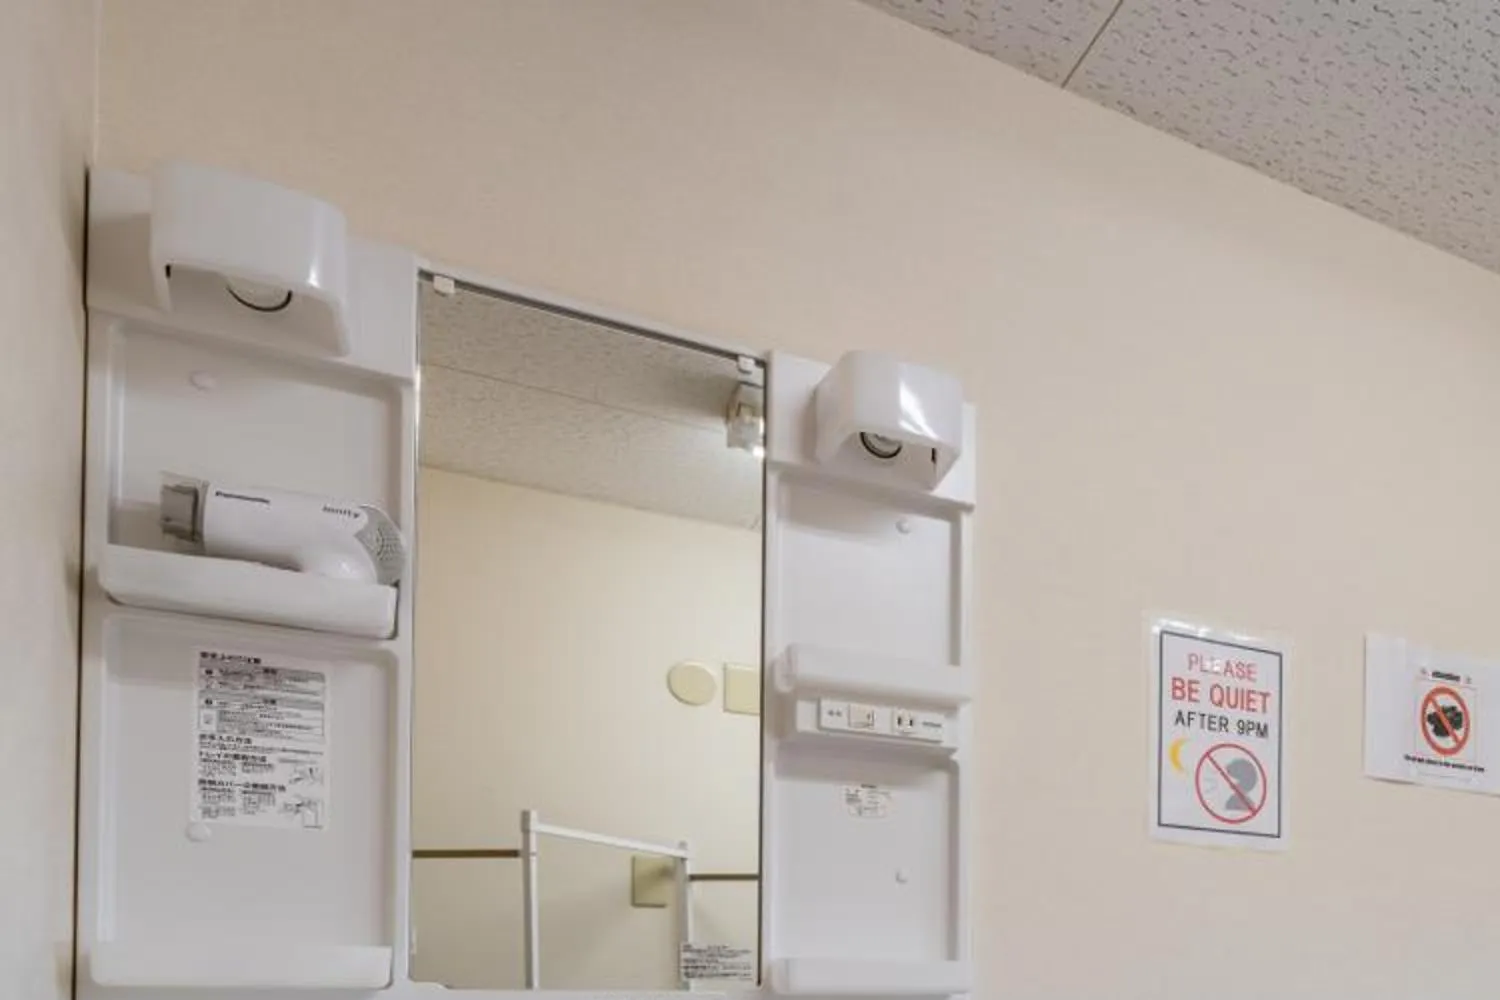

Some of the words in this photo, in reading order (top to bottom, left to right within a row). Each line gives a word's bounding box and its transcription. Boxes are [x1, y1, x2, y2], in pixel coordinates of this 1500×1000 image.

[1187, 653, 1257, 681] PLEASE
[1171, 677, 1200, 702] BE
[1209, 683, 1271, 713] QUIET
[1174, 709, 1229, 733] AFTER
[1237, 720, 1268, 738] 9PM
